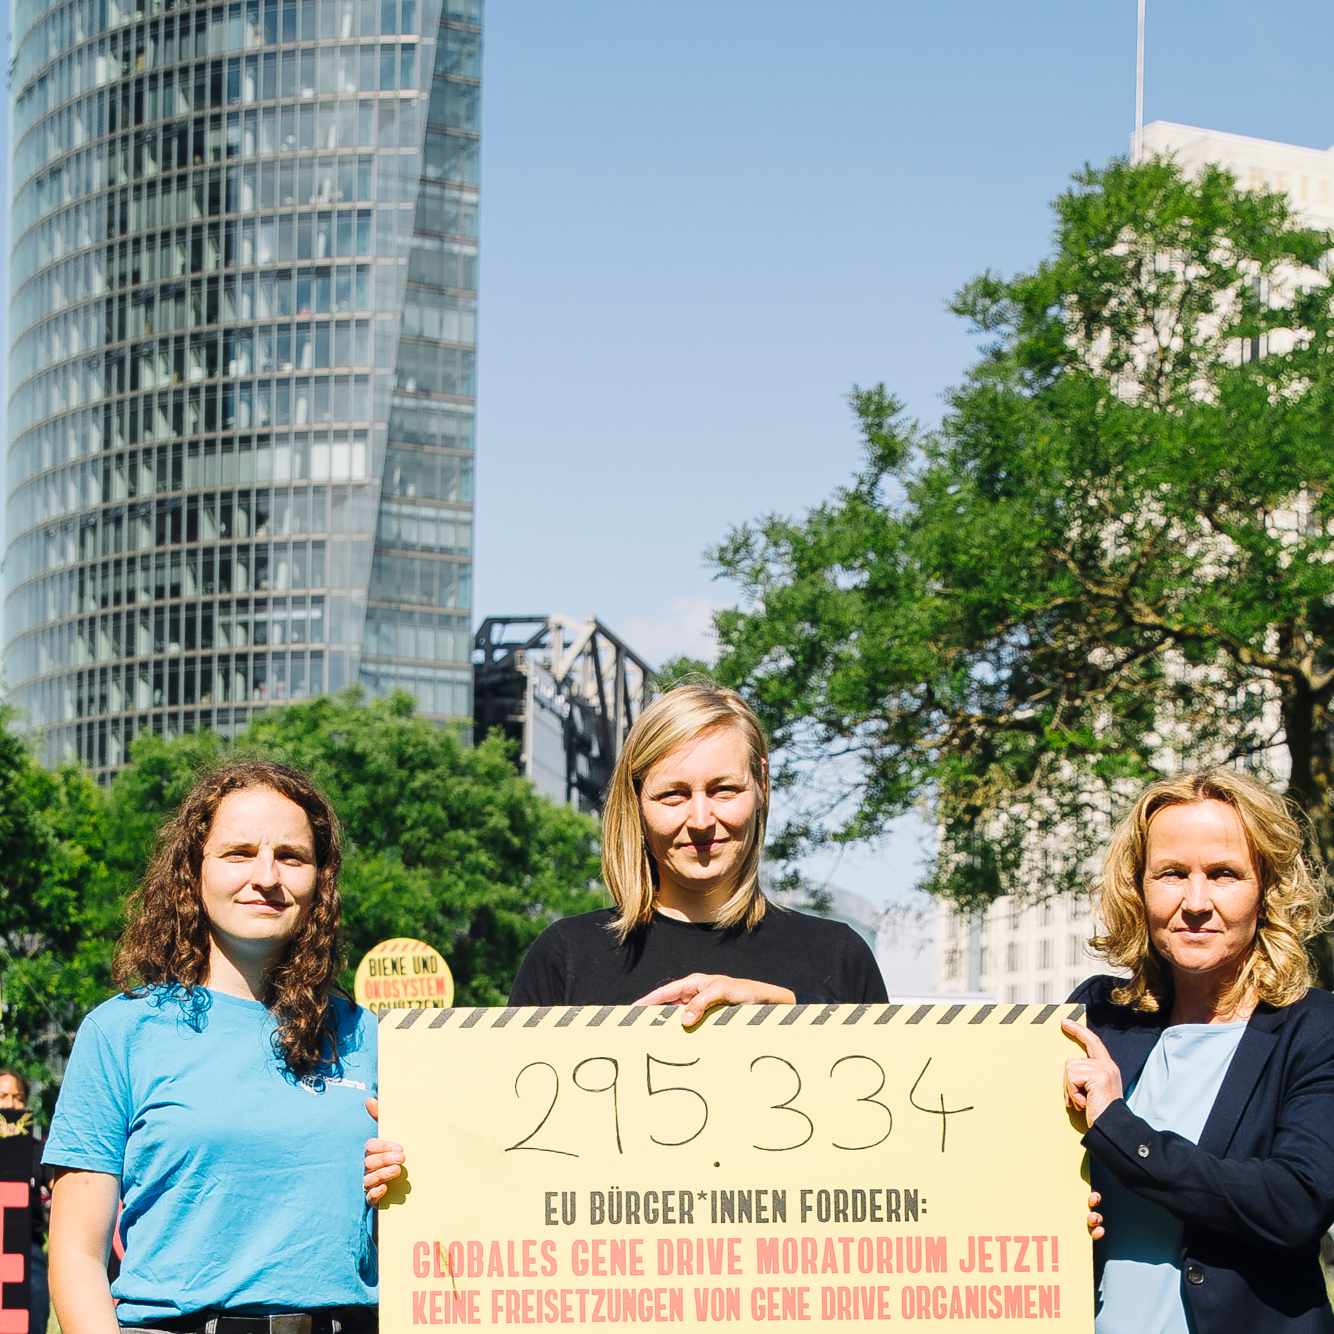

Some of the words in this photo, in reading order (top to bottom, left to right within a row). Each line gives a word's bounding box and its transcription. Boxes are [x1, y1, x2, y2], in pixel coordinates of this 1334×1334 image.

[368, 956, 408, 977] BIENE
[412, 954, 438, 975] UND
[364, 976, 447, 999] ÖKOSYSTEM
[505, 1053, 974, 1168] 295.334
[544, 1191, 577, 1226] EU
[800, 1188, 928, 1223] FORDERN:
[412, 1240, 558, 1279] GLOBALES
[571, 1239, 645, 1277] GENE
[657, 1238, 743, 1276] DRIVE
[756, 1236, 948, 1275] MORATORIUM
[959, 1235, 1060, 1273] JETZT!
[412, 1290, 481, 1325] KEINE
[491, 1287, 684, 1324] FREISETZUNGEN
[694, 1287, 741, 1322] VON
[750, 1287, 811, 1321] GENE
[821, 1286, 891, 1320] DRIVE
[901, 1285, 1061, 1319] ORGANISMEN!
